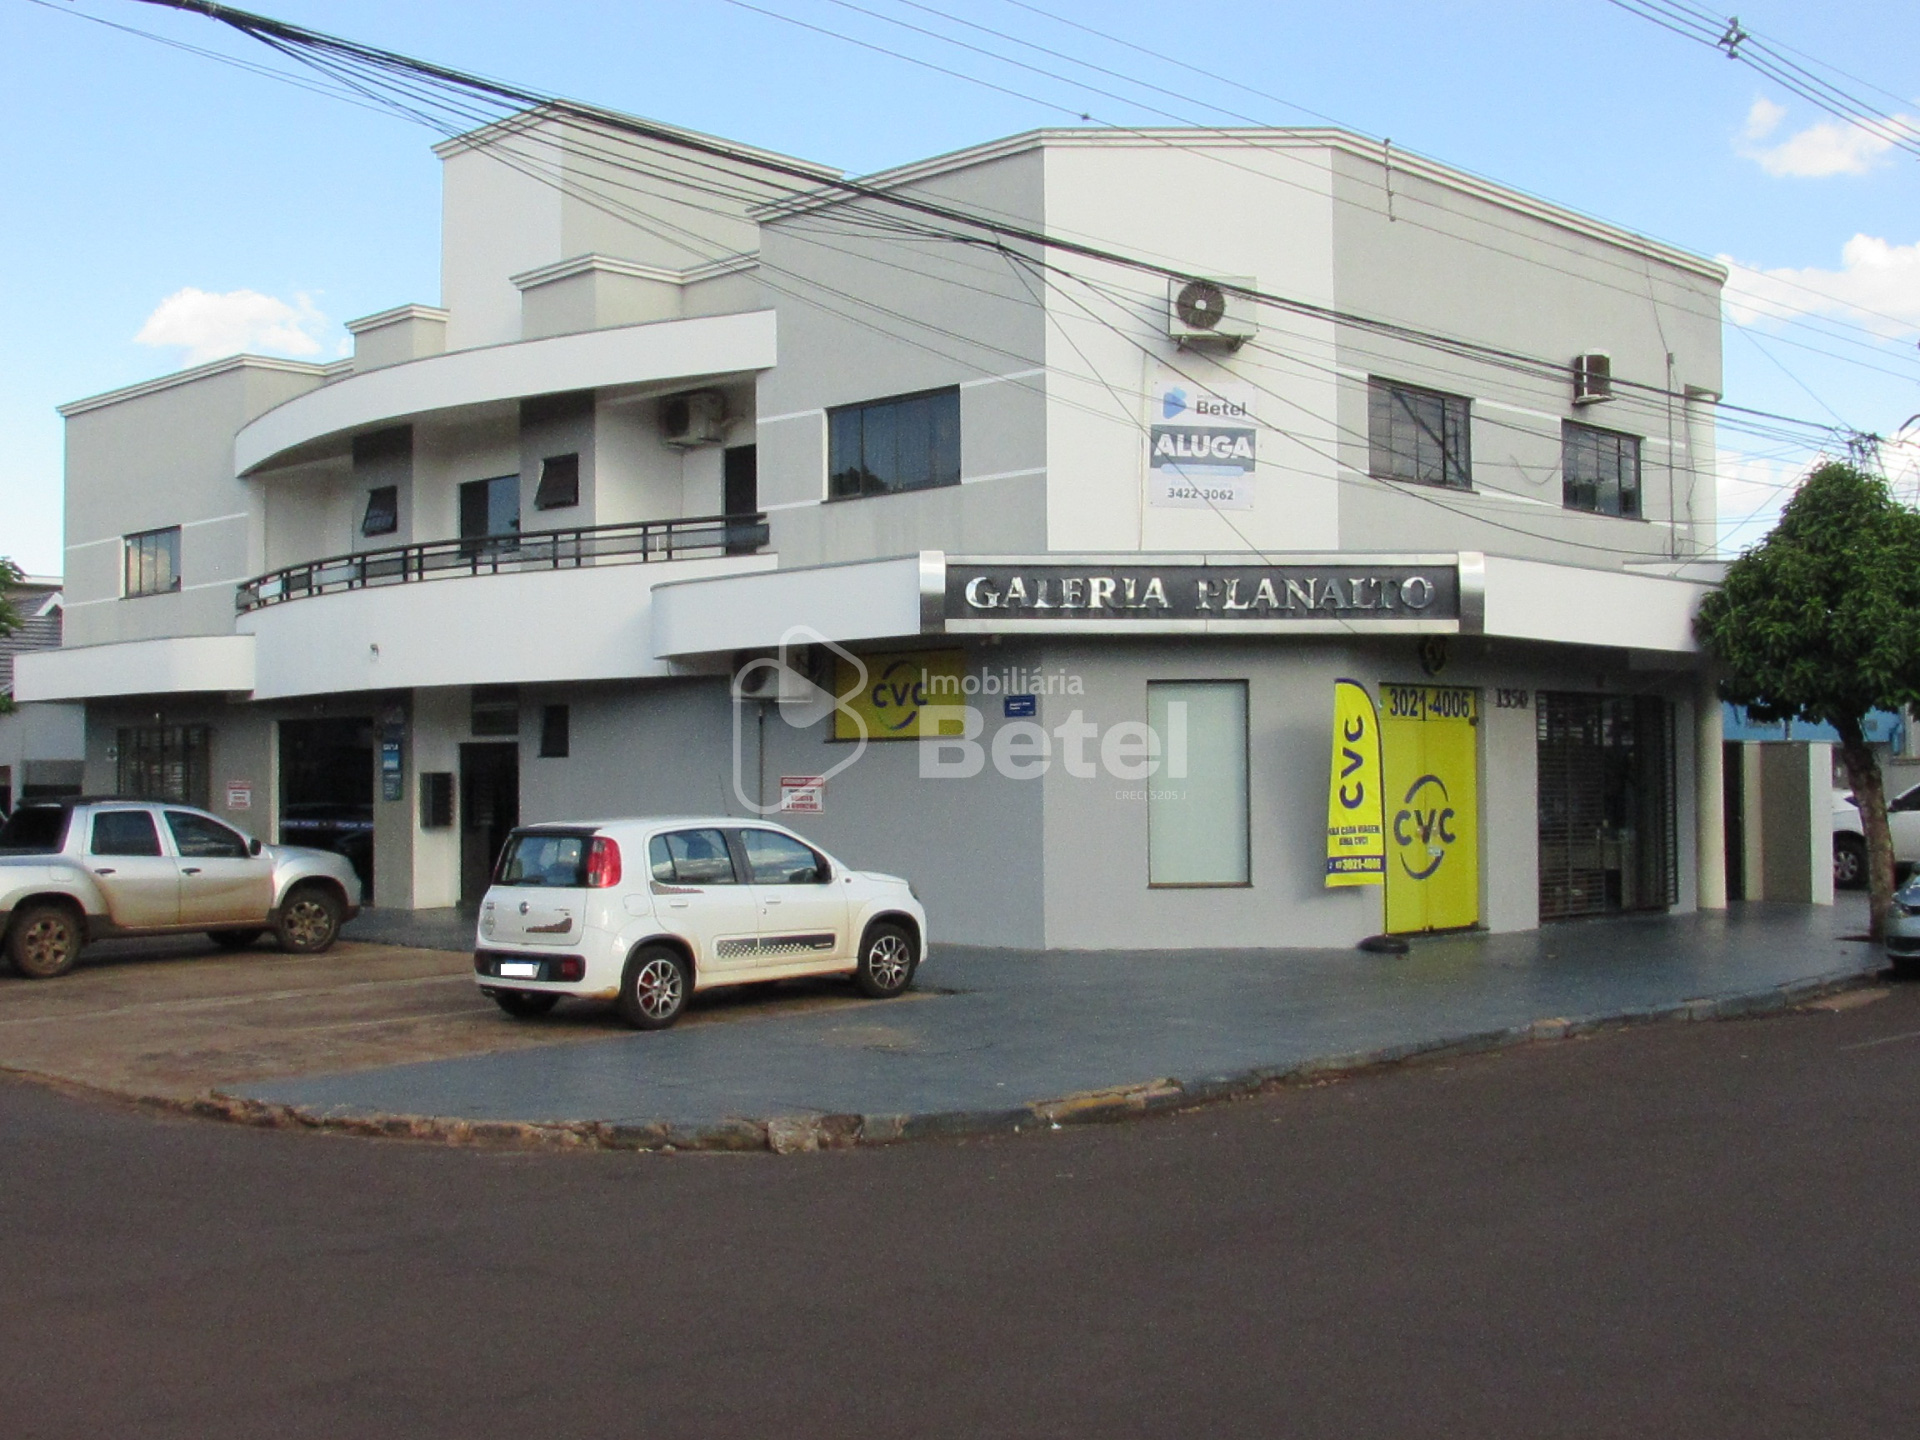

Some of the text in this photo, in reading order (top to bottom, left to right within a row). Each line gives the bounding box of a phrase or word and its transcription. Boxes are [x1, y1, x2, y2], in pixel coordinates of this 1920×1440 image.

[1196, 400, 1247, 416] Betel
[1154, 433, 1254, 460] ALUGA
[965, 576, 1435, 609] GALERIA PLANALTO
[872, 681, 929, 708] CVC
[1389, 688, 1470, 718] 3021-4006
[1340, 715, 1364, 809] CVC
[1393, 808, 1456, 846] CVC
